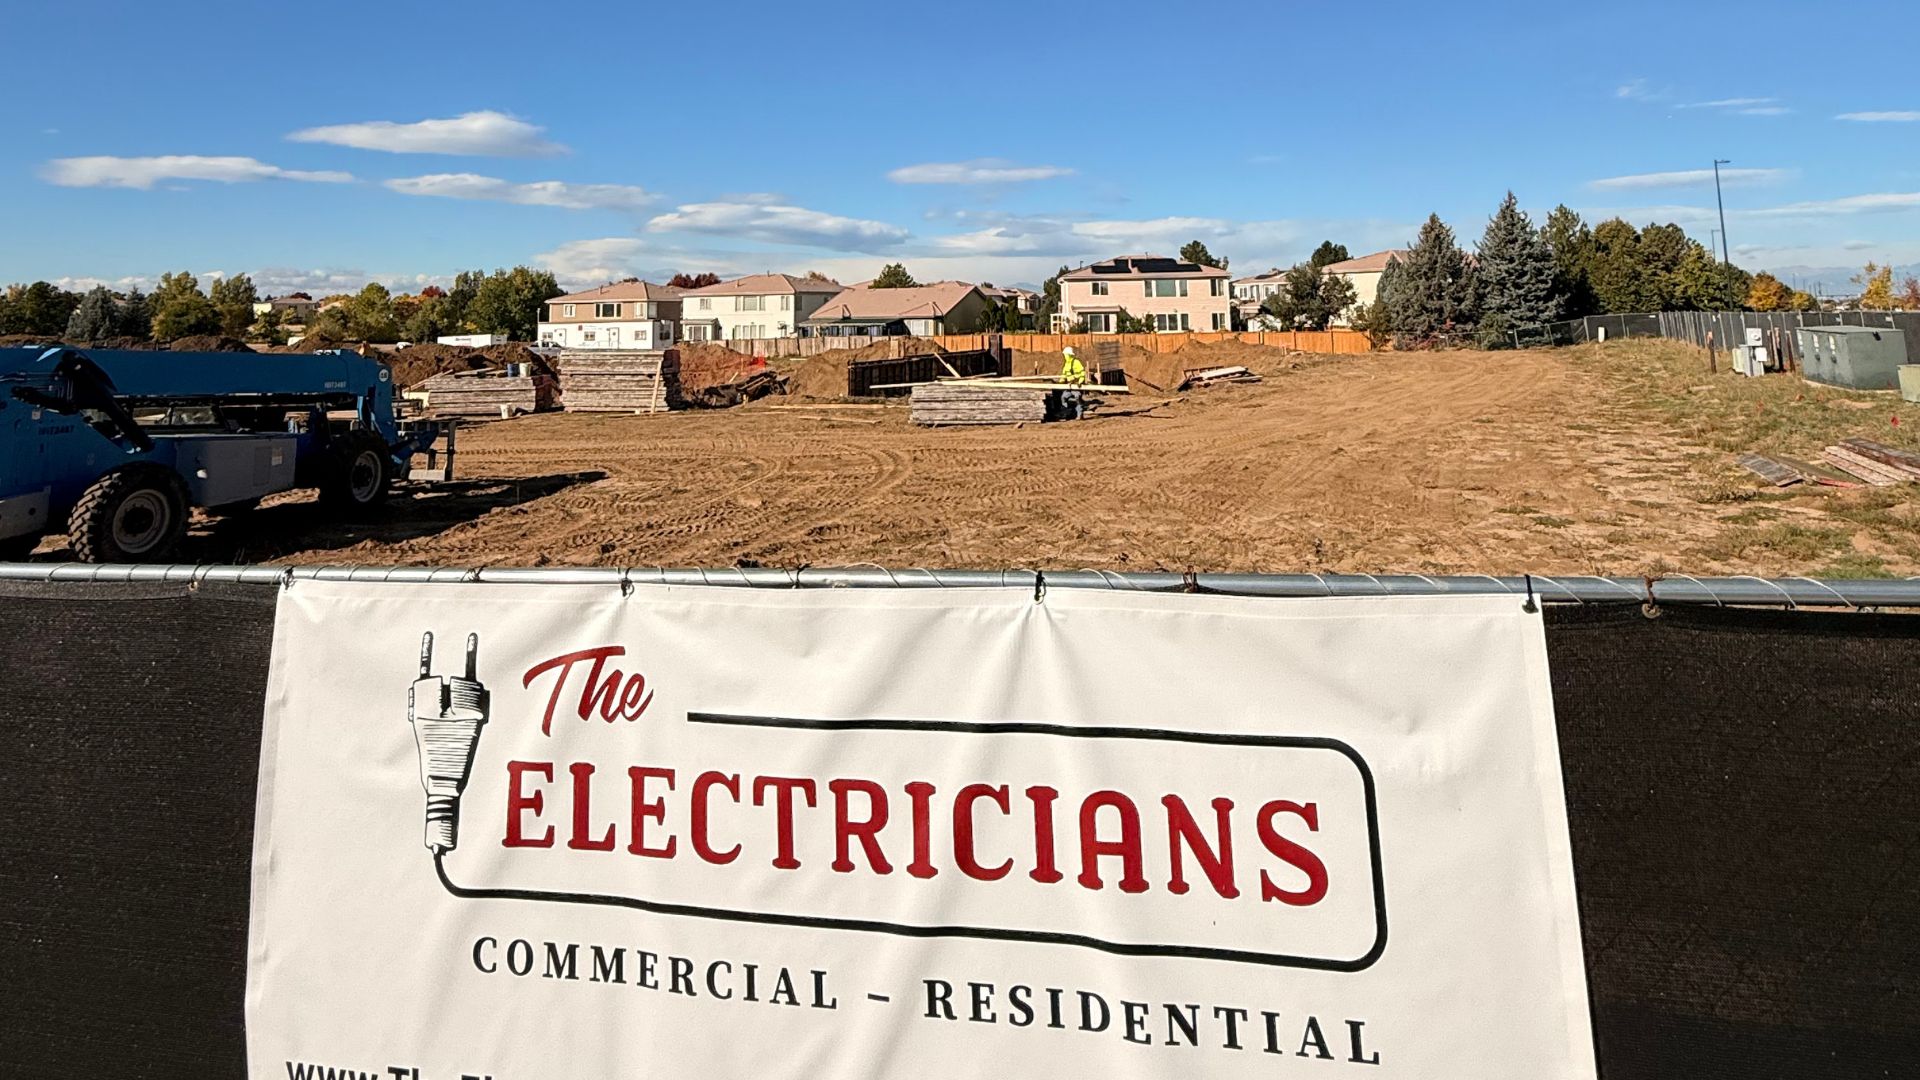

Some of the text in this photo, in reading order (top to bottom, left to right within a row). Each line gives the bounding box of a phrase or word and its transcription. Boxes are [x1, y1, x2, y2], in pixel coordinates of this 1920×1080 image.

[522, 645, 653, 737] The
[501, 759, 1331, 908] ELECTRICIANS
[472, 936, 838, 1010] COMMERCIAL
[922, 979, 1380, 1065] RESIDENTIAL
